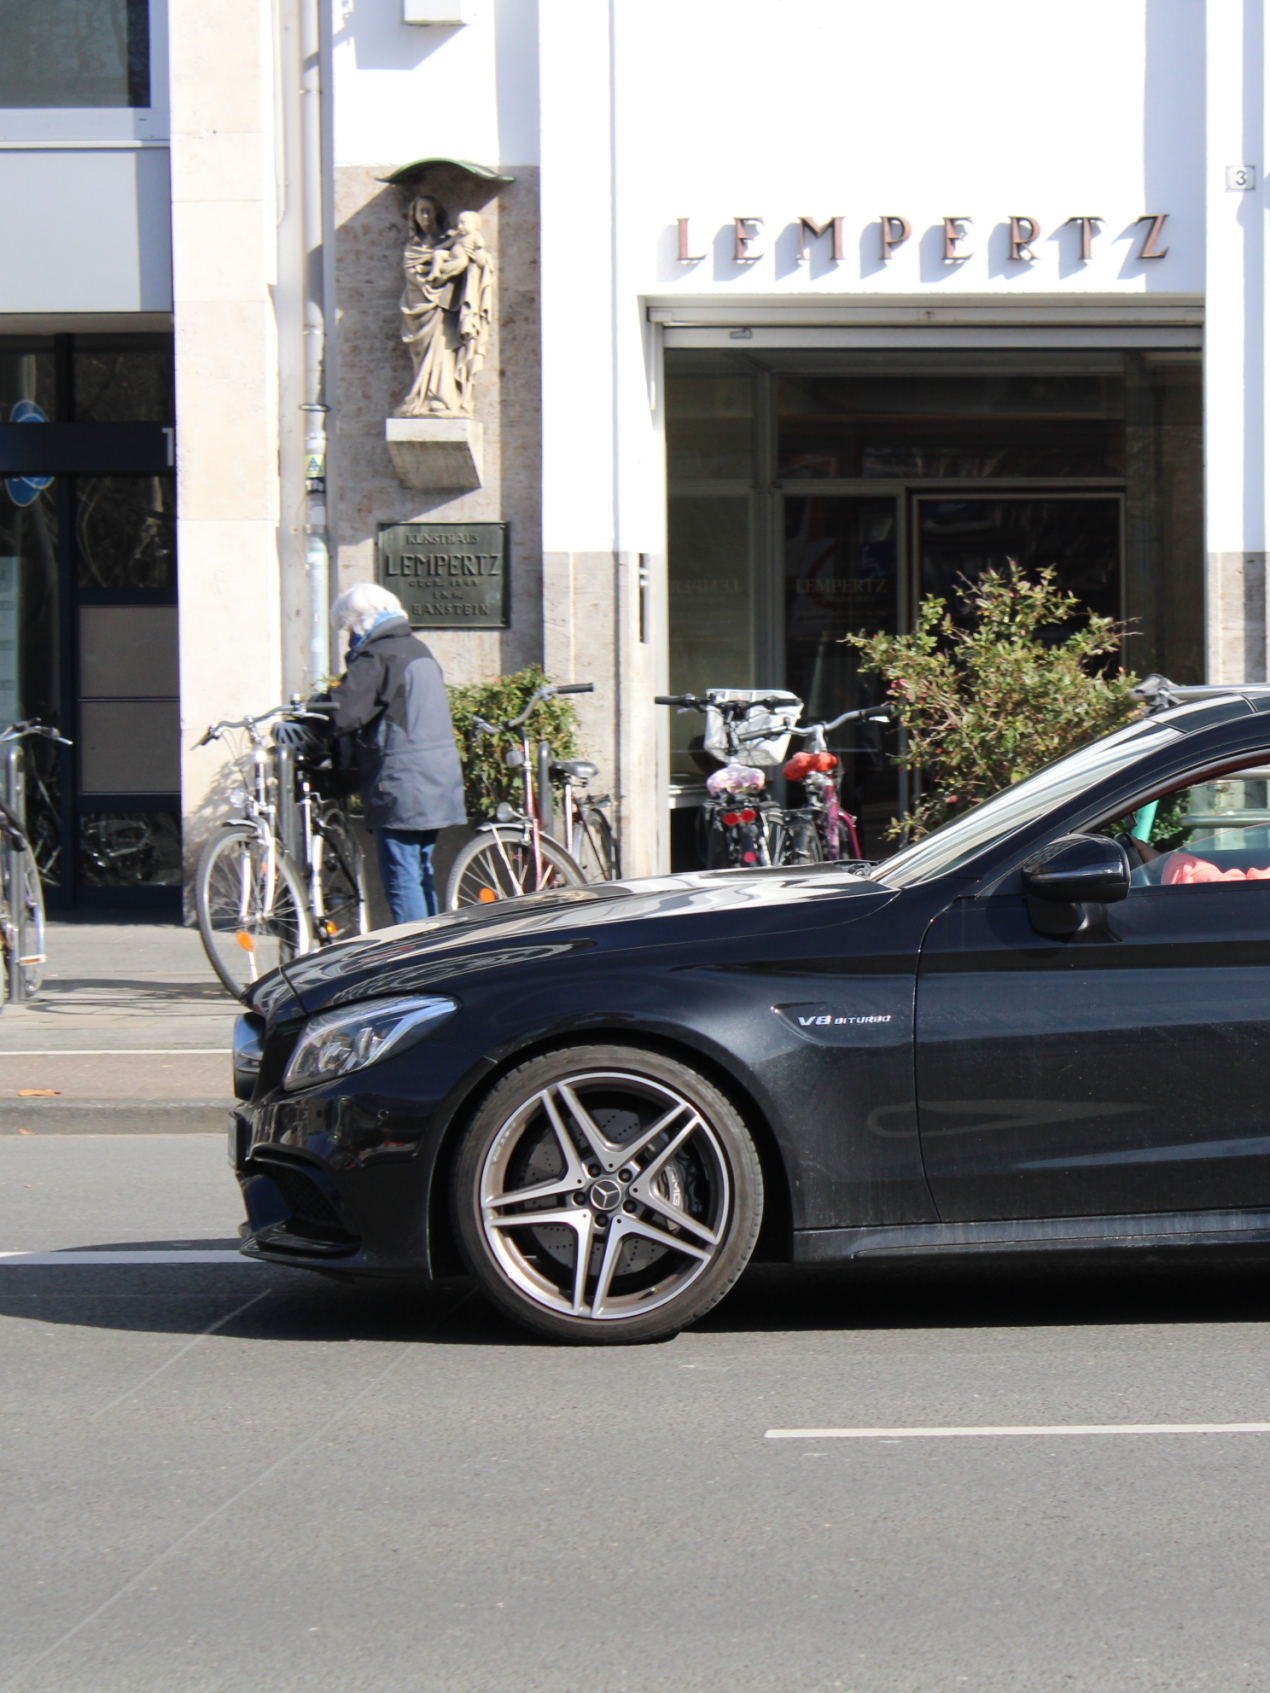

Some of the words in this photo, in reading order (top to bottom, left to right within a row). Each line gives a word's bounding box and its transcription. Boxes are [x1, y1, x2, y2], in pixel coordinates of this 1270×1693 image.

[1236, 170, 1247, 186] 3
[676, 214, 1170, 261] LEMPERTZ
[162, 427, 174, 467] 1
[405, 533, 479, 545] KUNSTHAUS
[384, 553, 503, 577] LEMPERTZ
[795, 578, 888, 593] LEMPERTZ
[798, 1015, 831, 1027] V8
[834, 1015, 892, 1026] BITURBO
